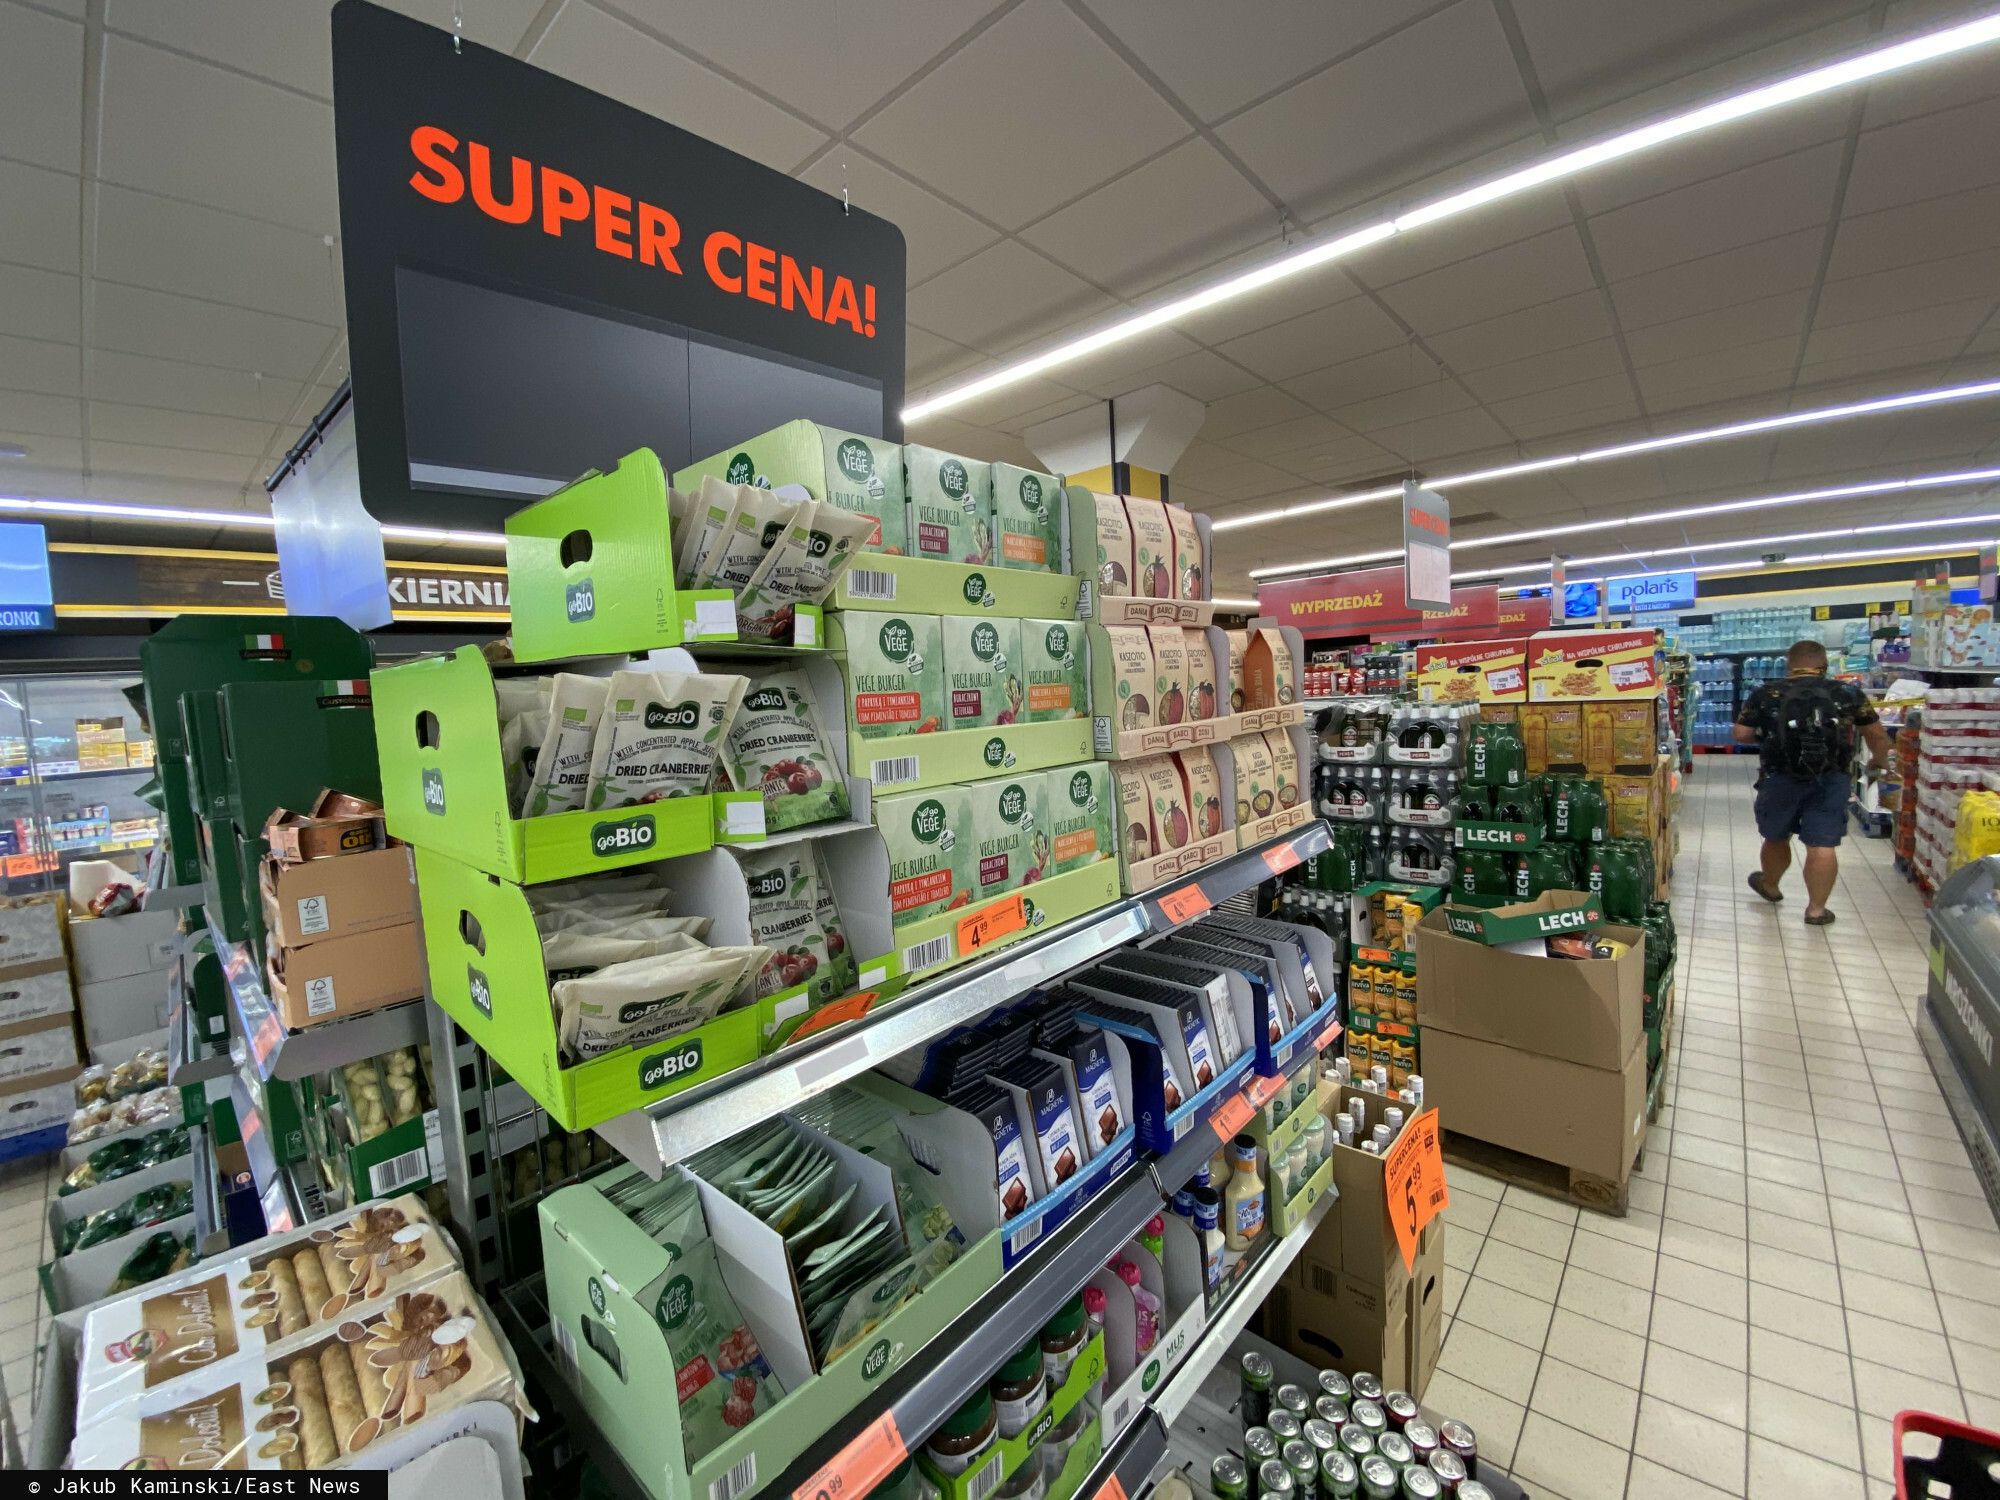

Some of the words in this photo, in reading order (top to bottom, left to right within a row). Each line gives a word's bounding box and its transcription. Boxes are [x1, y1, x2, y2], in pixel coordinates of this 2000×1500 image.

[409, 126, 683, 275] SUPER
[703, 231, 876, 338] CENA!
[856, 448, 867, 458] go
[843, 452, 869, 474] VEGE
[943, 474, 963, 492] VEGE
[1022, 486, 1039, 504] VEGE
[919, 505, 936, 523] VEGE
[938, 508, 961, 528] BURGER
[727, 556, 743, 565] WITH
[967, 581, 982, 597] VEGE
[1621, 578, 1679, 600] polaris
[1130, 607, 1148, 617] DANIA
[1157, 605, 1173, 615] BABCI
[1291, 590, 1383, 615] WYPRZEDAŻ
[896, 628, 907, 636] go
[884, 634, 908, 652] VEGE
[975, 635, 994, 652] VEGE
[1049, 635, 1065, 652] VEGE
[1607, 638, 1643, 653] CHRUPANIE
[855, 675, 874, 692] VEGE
[877, 674, 906, 691] BURGER
[952, 673, 968, 688] VEGE
[969, 672, 993, 688] BURGER
[1028, 670, 1041, 684] VEGE
[748, 692, 784, 709] goBIO
[648, 706, 696, 725] goBIO
[740, 738, 766, 753] DRIED
[766, 733, 817, 748] CRANBERRIES
[1147, 734, 1166, 745] DANIA
[1173, 727, 1190, 738] BABCI
[615, 746, 634, 759] WITH
[635, 735, 677, 750] CONCENTRATED
[681, 737, 700, 749] APPLE
[987, 747, 1003, 761] VEGE
[559, 755, 580, 766] WITH
[1474, 742, 1486, 779] LECH
[615, 766, 648, 777] DRIED
[1012, 791, 1022, 799] go
[1072, 780, 1089, 799] VEGE
[929, 808, 939, 817] go
[1002, 798, 1022, 815] VEGE
[917, 814, 940, 834] VEGE
[1054, 822, 1068, 836] VEGE
[1068, 816, 1086, 833] BURGER
[1259, 824, 1272, 833] DANIA
[1276, 816, 1288, 825] BABCI
[1556, 799, 1569, 834] LECH
[597, 822, 652, 850] goBIO
[979, 843, 996, 857] VEGE
[996, 834, 1019, 853] BURGER
[1467, 829, 1512, 843] LECH
[909, 854, 938, 876] BURGER
[1158, 861, 1176, 873] DANIA
[1183, 852, 1199, 863] BABCI
[1207, 845, 1218, 855] ZOSI
[1309, 854, 1318, 879] LEC
[1517, 868, 1529, 896] ECH
[761, 912, 814, 936] CRANBERRIES
[1451, 919, 1476, 935] LECH
[1539, 911, 1585, 931] LECH
[971, 925, 980, 948] 4
[979, 920, 988, 931] 99
[644, 1049, 699, 1083] goBIO
[1085, 1056, 1105, 1073] MAGNETIC
[1041, 1095, 1064, 1115] MAGNETIC
[1389, 1126, 1421, 1180] SUPERCENA!
[1405, 1174, 1417, 1237] 5
[1411, 1162, 1421, 1184] 99
[674, 1283, 686, 1295] go
[661, 1297, 689, 1323] VEGE
[1166, 1329, 1185, 1358] MUS
[865, 1356, 887, 1375] VEGE
[828, 1474, 843, 1493] 99
